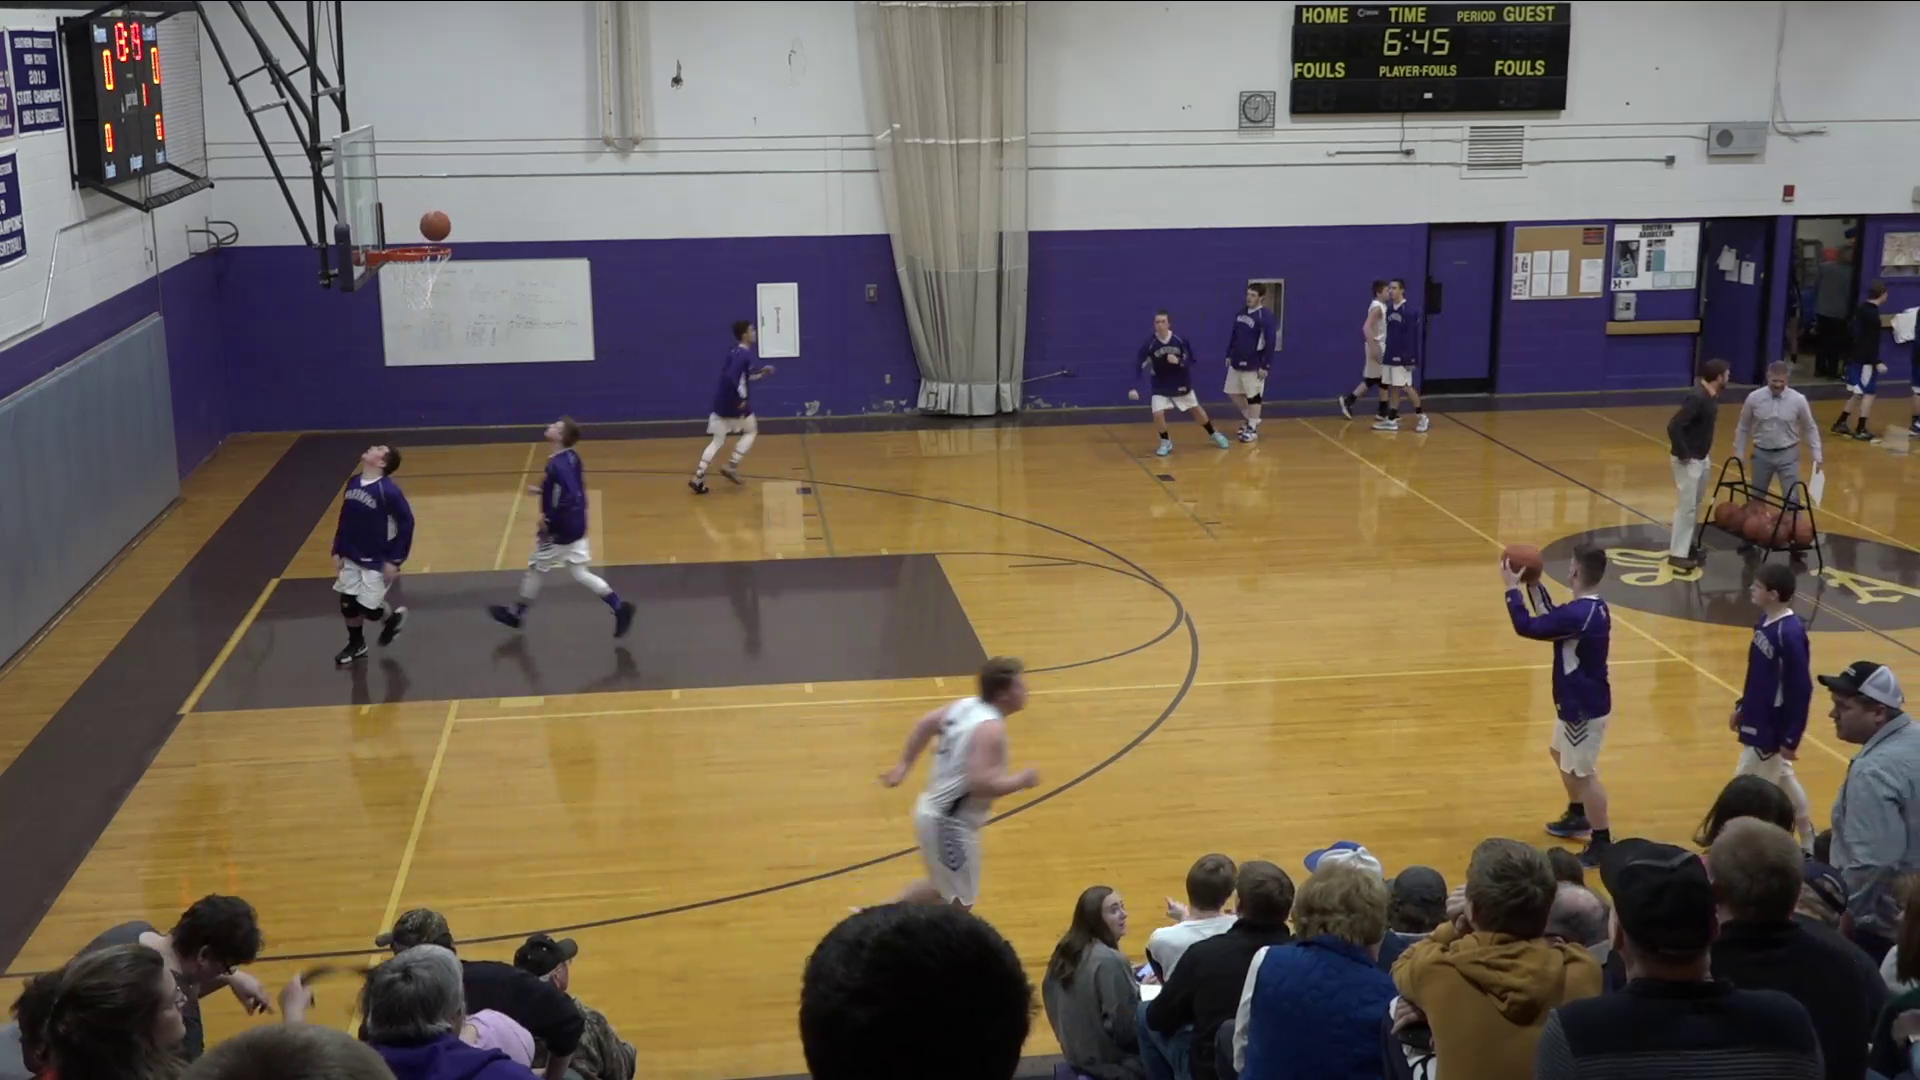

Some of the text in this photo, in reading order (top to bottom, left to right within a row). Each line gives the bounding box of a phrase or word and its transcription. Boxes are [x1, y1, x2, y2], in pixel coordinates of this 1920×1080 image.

[1302, 7, 1349, 23] HOME
[1388, 7, 1427, 23] TIME
[1456, 10, 1496, 22] PERIOD
[1503, 6, 1555, 22] GUEST
[1382, 28, 1450, 56] 6:45
[1294, 62, 1346, 78] FOULS
[1494, 60, 1546, 76] FOULS
[28, 70, 47, 85] 2019
[16, 90, 33, 105] STATE
[33, 88, 61, 104] CHAMPIONS
